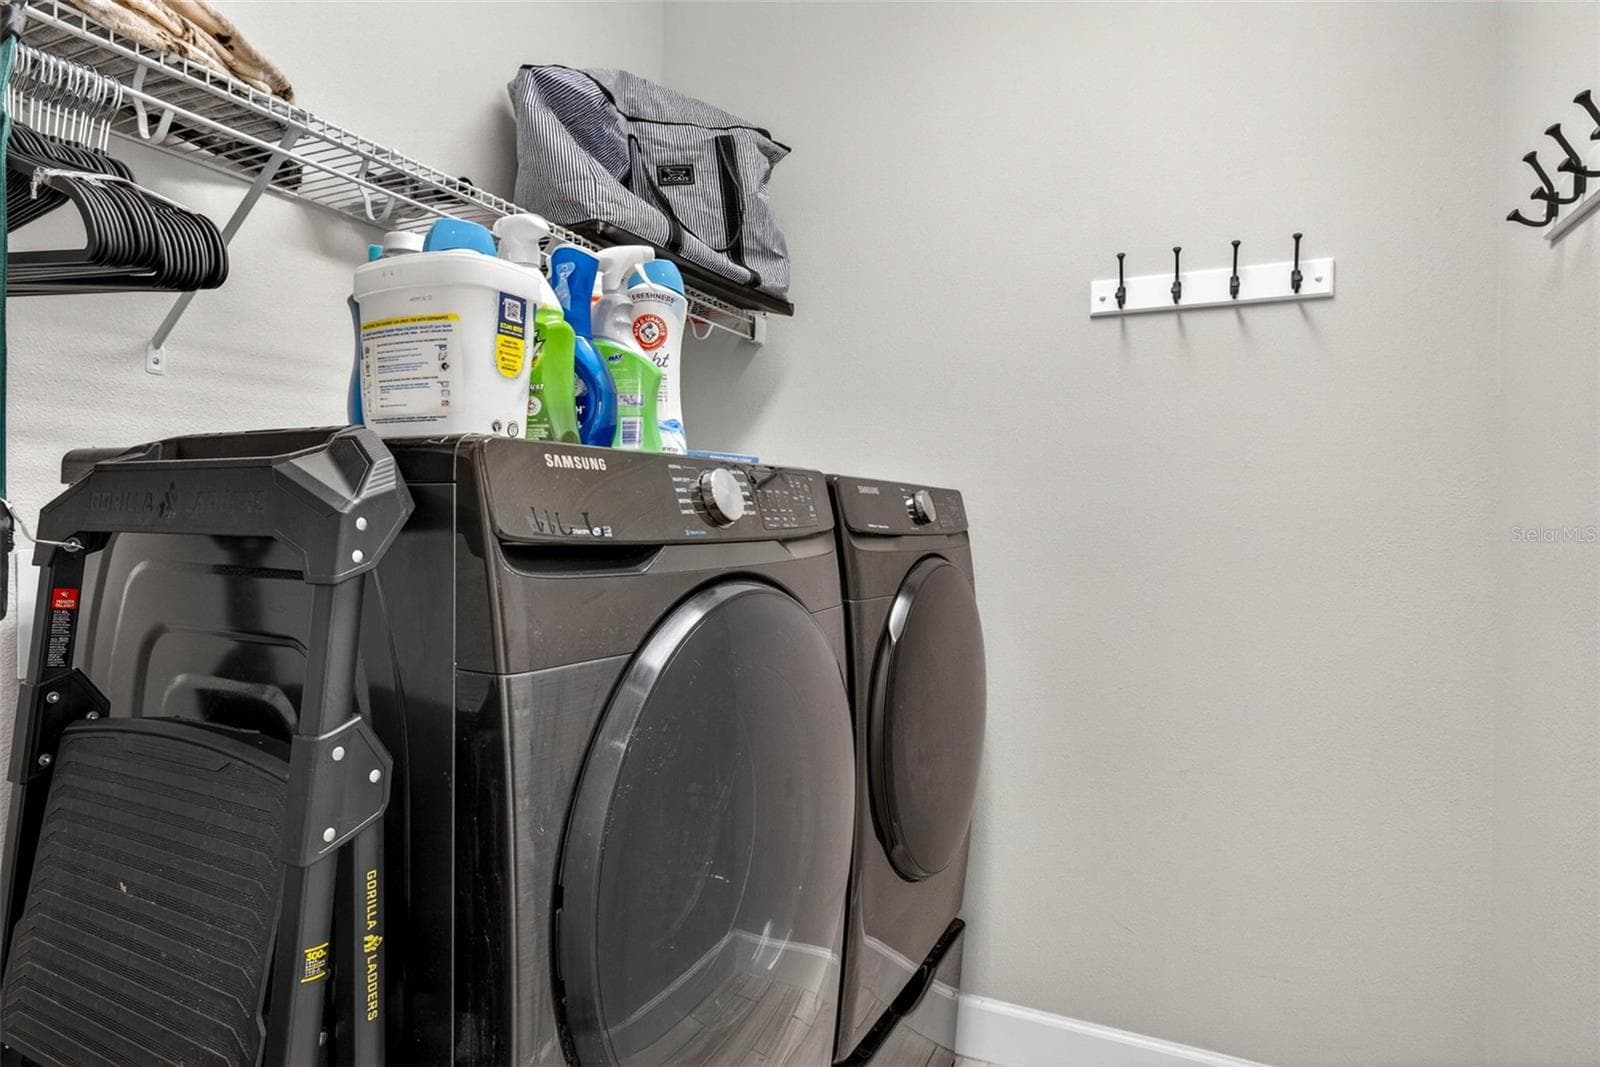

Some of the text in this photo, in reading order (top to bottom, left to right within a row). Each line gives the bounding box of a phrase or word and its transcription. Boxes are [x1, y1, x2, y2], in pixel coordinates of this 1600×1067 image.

[543, 453, 607, 471] SAMSUNG
[366, 869, 379, 1022] GORILLA LADDERS
